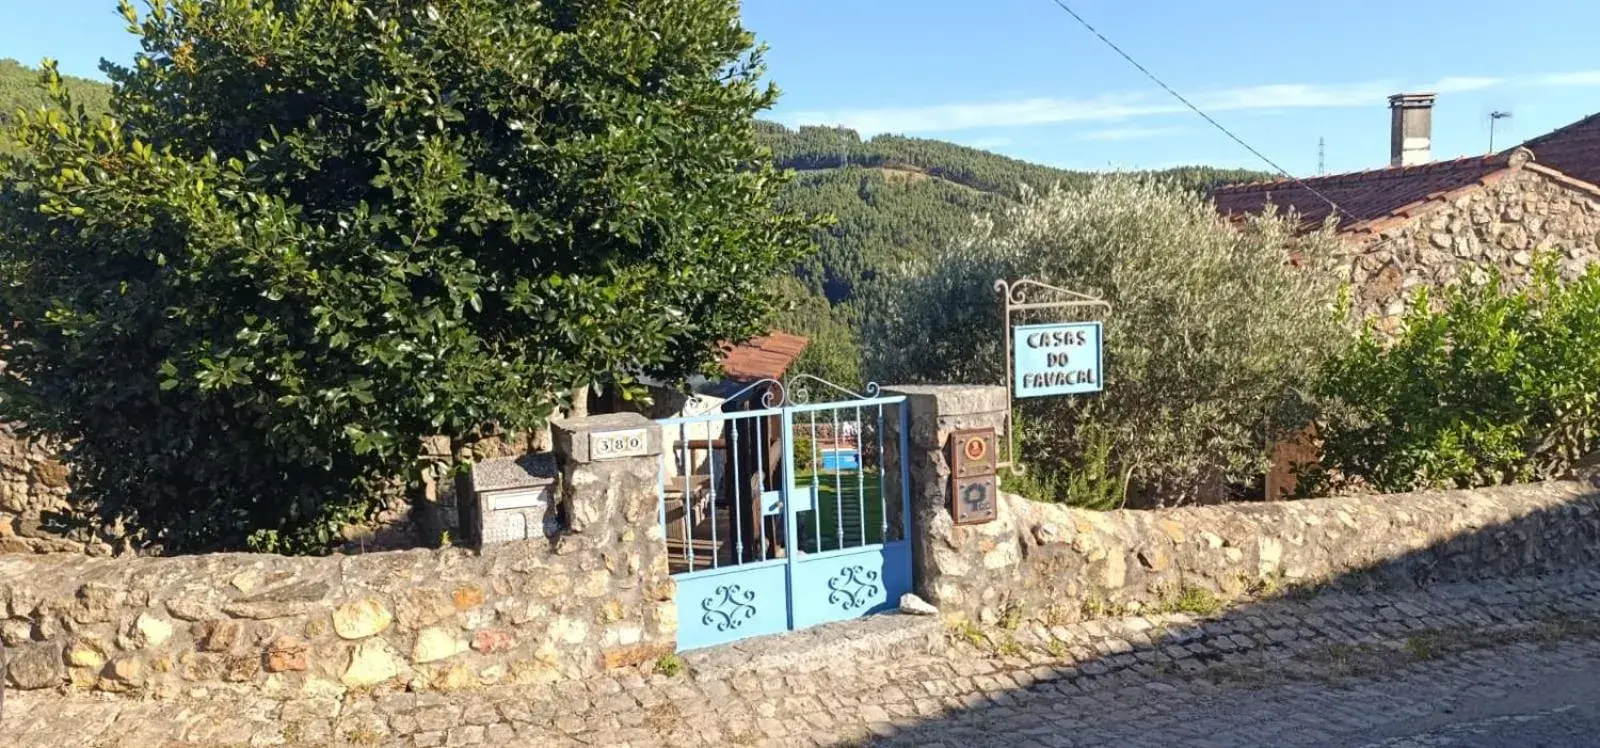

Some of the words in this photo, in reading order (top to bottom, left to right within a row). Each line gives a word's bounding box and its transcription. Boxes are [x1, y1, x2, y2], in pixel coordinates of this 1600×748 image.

[1026, 330, 1086, 349] CASAS
[1047, 352, 1069, 368] DO
[1023, 368, 1095, 388] FAVACAL
[601, 438, 639, 450] 380
